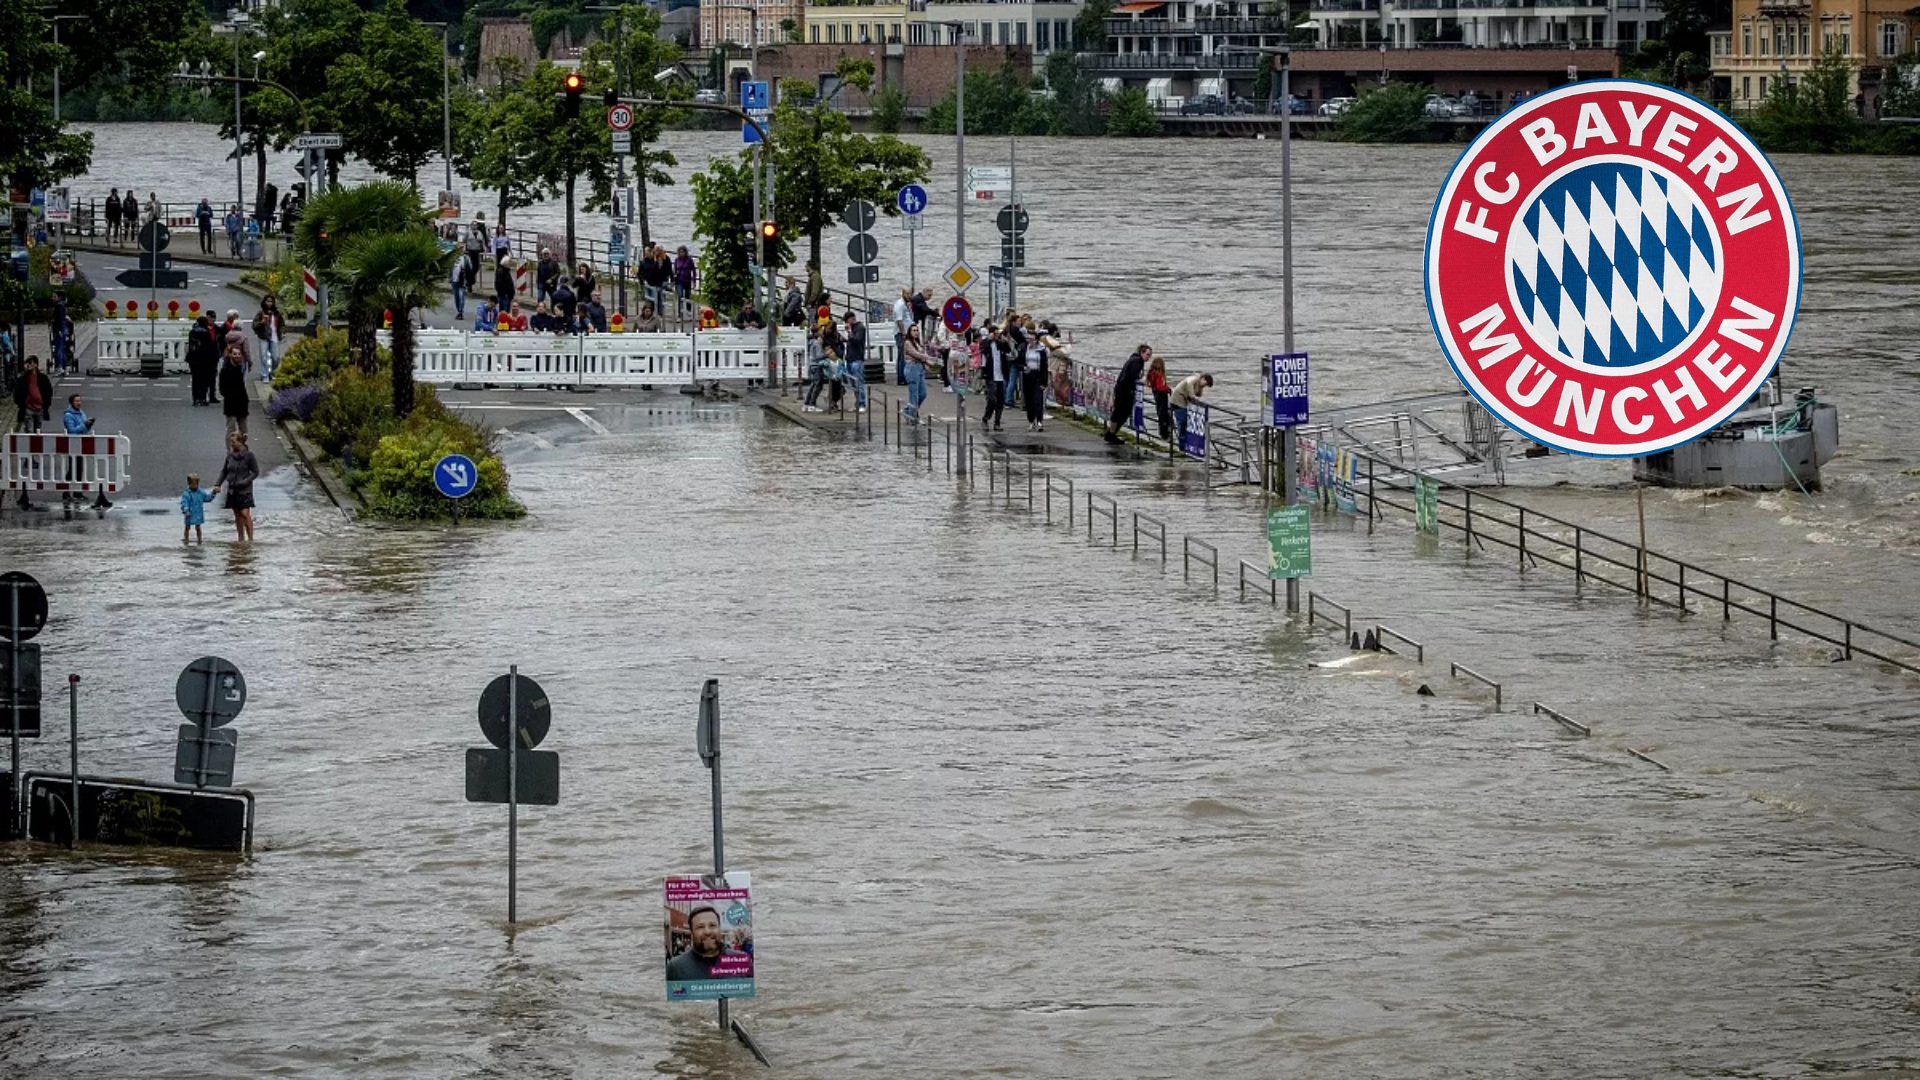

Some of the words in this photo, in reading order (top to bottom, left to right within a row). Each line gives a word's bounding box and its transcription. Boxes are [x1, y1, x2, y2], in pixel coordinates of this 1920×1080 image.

[613, 111, 628, 124] 30
[1274, 358, 1307, 372] POWER
[1274, 372, 1291, 386] TO
[1291, 370, 1307, 385] THE
[1274, 384, 1308, 399] PEOPLE
[688, 892, 716, 900] möglich
